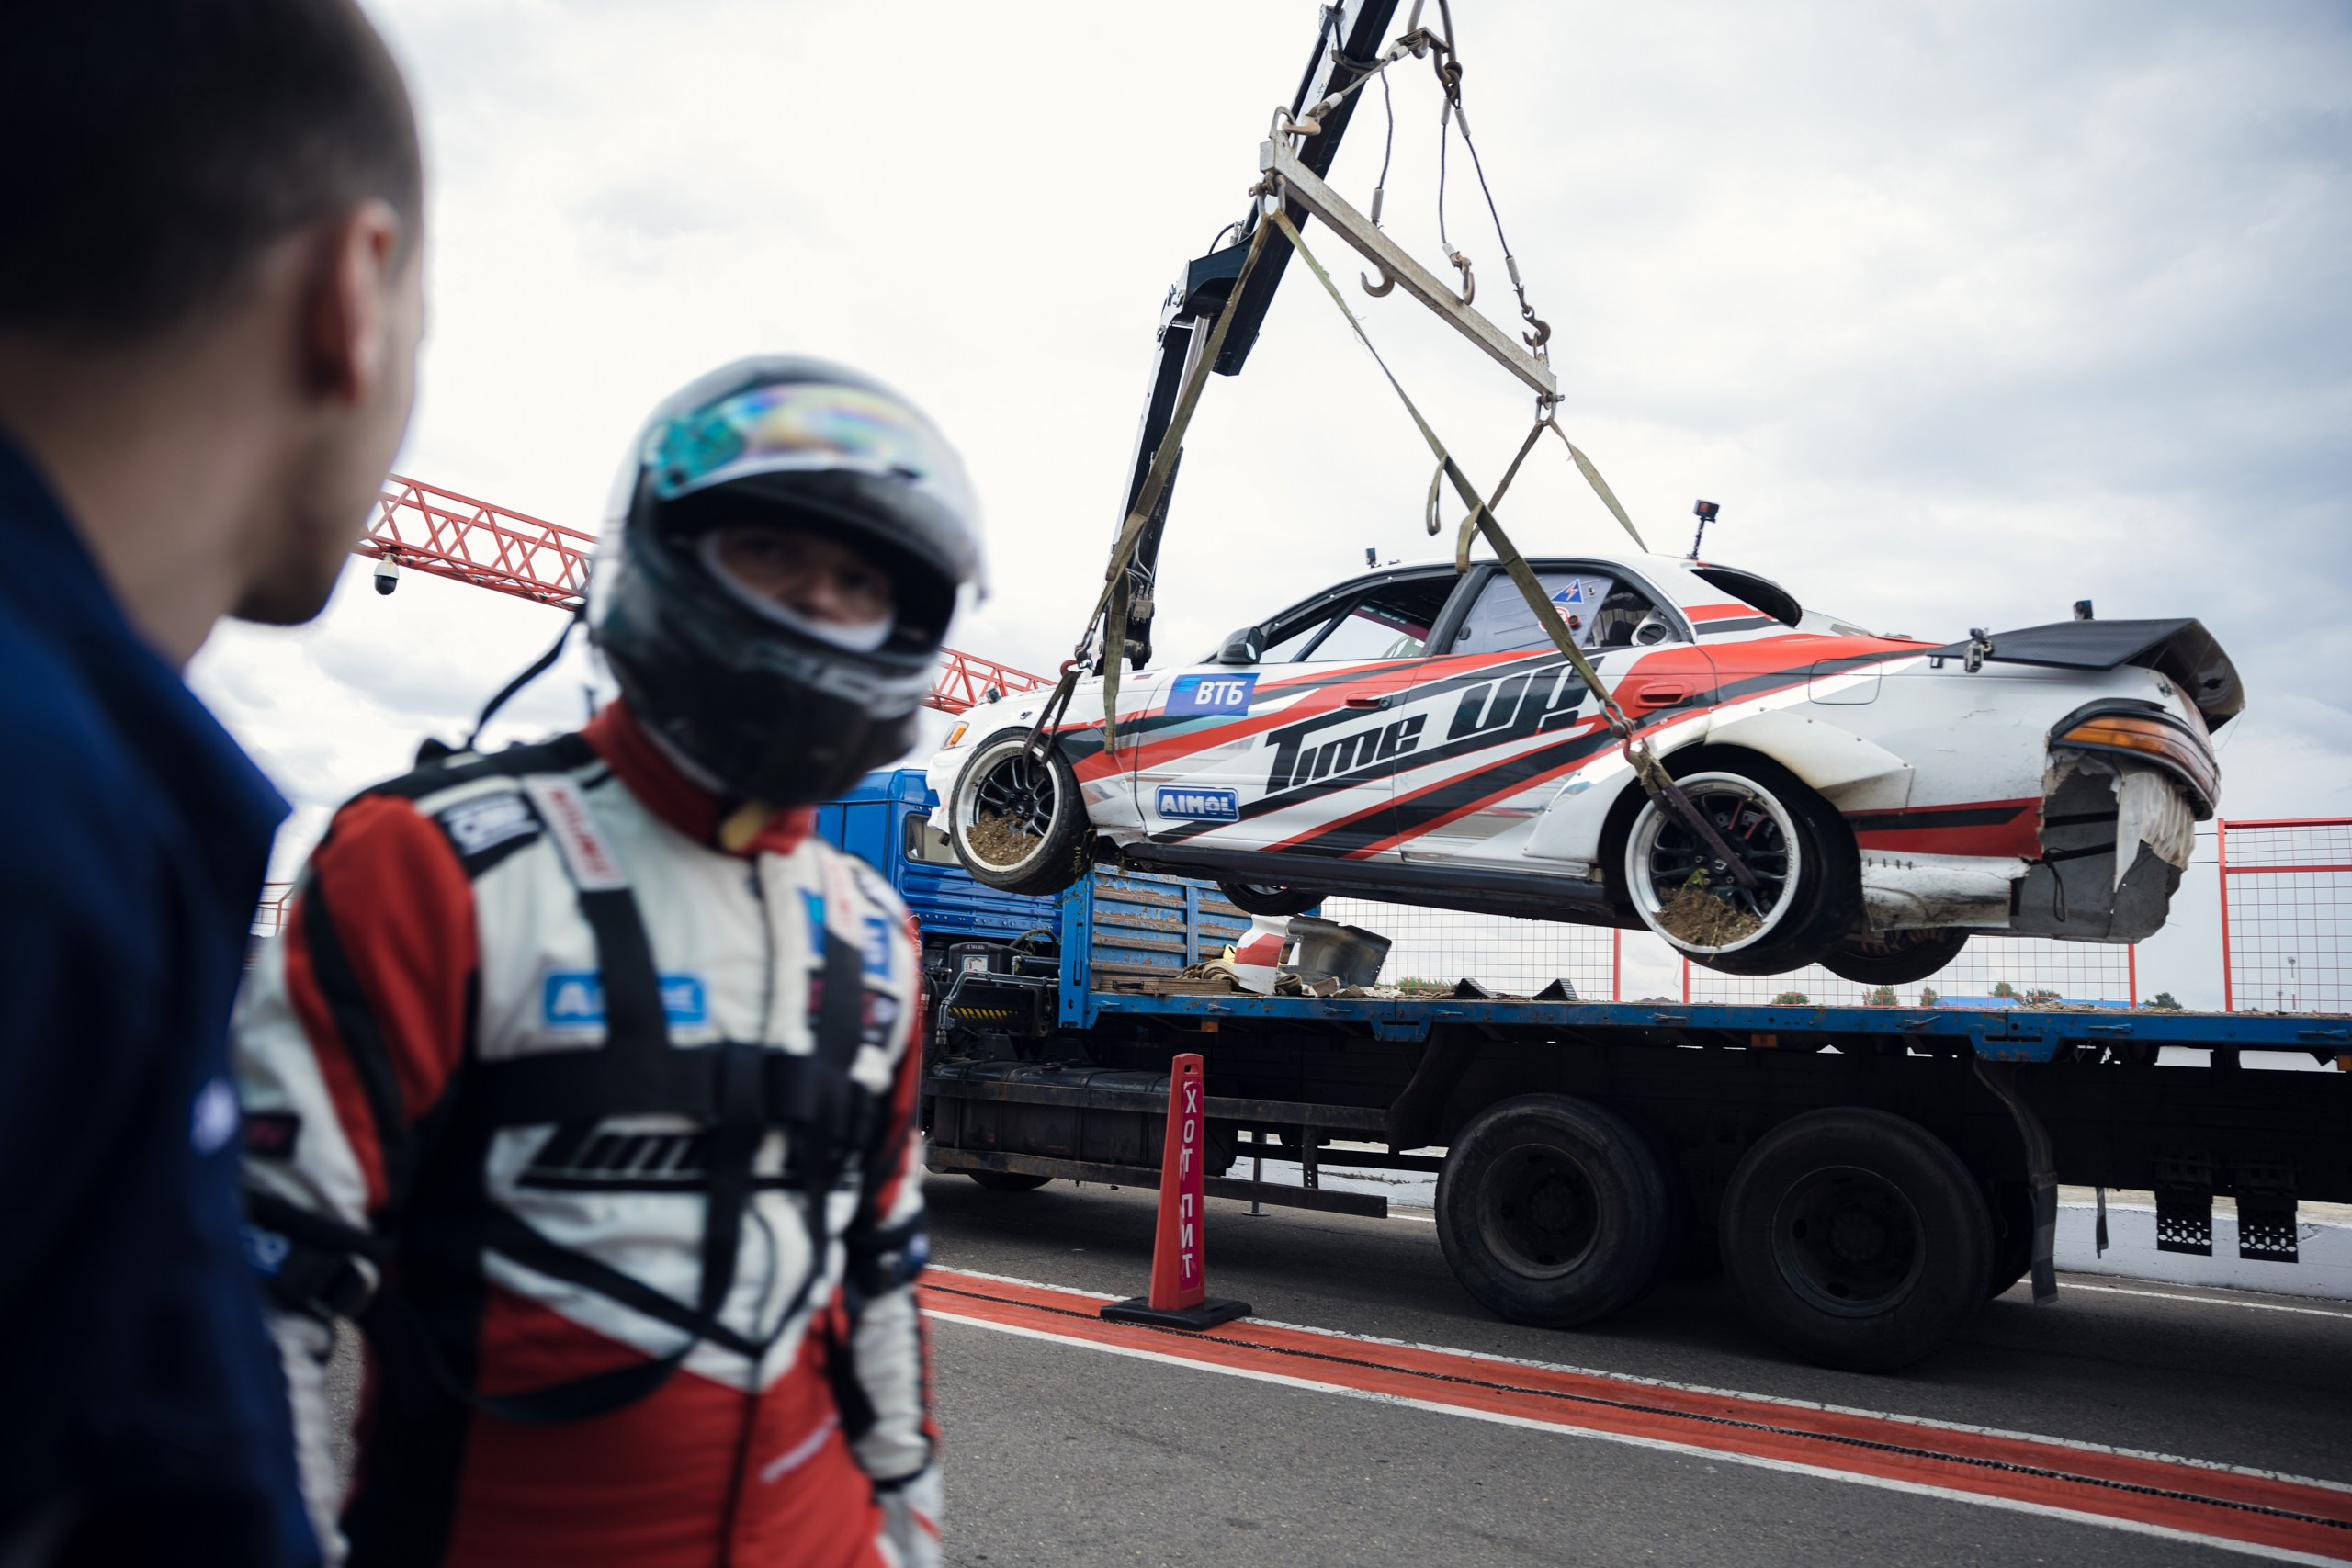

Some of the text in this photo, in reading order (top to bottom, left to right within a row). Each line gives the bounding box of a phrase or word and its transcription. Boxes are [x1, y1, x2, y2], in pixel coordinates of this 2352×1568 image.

[1194, 681, 1247, 705] ВТБ
[1160, 794, 1235, 816] AIMOL
[1181, 1089, 1197, 1278] ХОТ ПИТ
